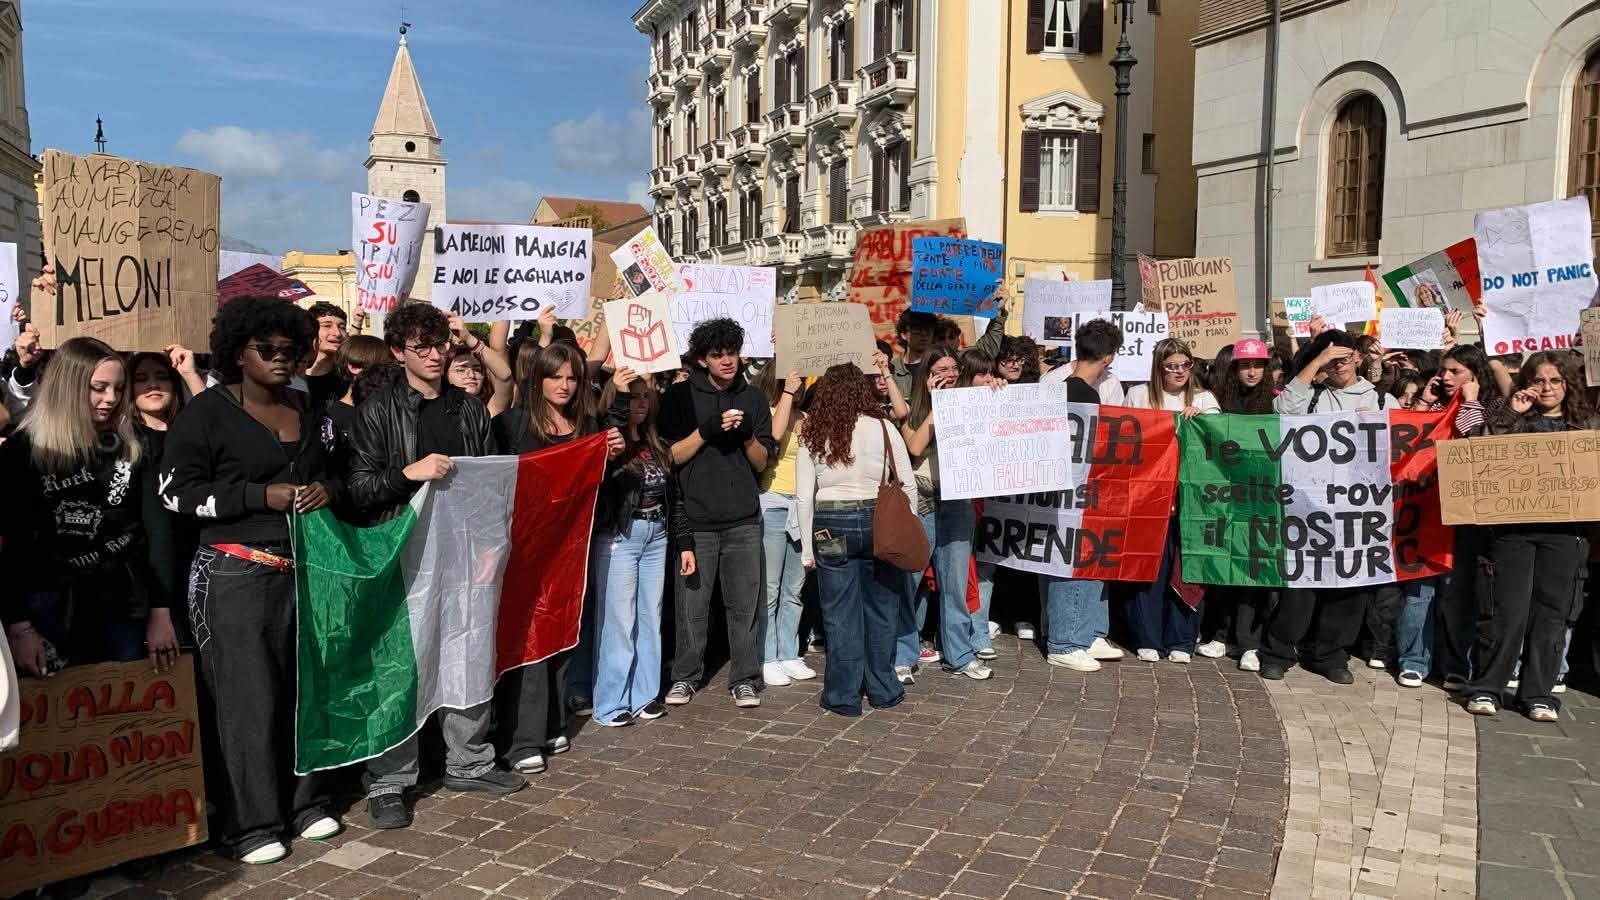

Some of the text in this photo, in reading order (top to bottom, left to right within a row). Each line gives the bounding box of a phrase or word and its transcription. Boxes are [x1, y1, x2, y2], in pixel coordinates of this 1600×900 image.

[84, 158, 190, 194] VERDURA
[51, 184, 177, 213] AUMENTA
[53, 211, 218, 253] MANGEREMO
[368, 222, 397, 246] SU
[434, 225, 587, 260] LA MELONI MANGIA
[54, 253, 172, 326] MELONI
[433, 266, 586, 285] E NOI LE CAGHIAMO
[1483, 275, 1505, 291] DO
[1512, 271, 1539, 289] NOT
[1547, 263, 1592, 283] PANIC
[450, 295, 540, 317] ADDOSSO
[1163, 282, 1217, 301] FUNERAL
[1165, 299, 1203, 317] PYRE
[965, 437, 1049, 467] GOVERNO
[1204, 431, 1241, 466] le
[1447, 443, 1508, 465] ANCHE
[1514, 441, 1538, 459] SE
[1545, 440, 1566, 457] VI
[992, 458, 1069, 491] FALLITO
[1201, 474, 1295, 505] scelte
[1449, 478, 1500, 498] SIETE
[1508, 478, 1532, 494] LO
[1472, 495, 1580, 516] COINVOLTI
[1203, 515, 1226, 548] il
[66, 679, 177, 721] ALLA
[109, 718, 196, 768] NON
[46, 788, 197, 855] GUERRA
